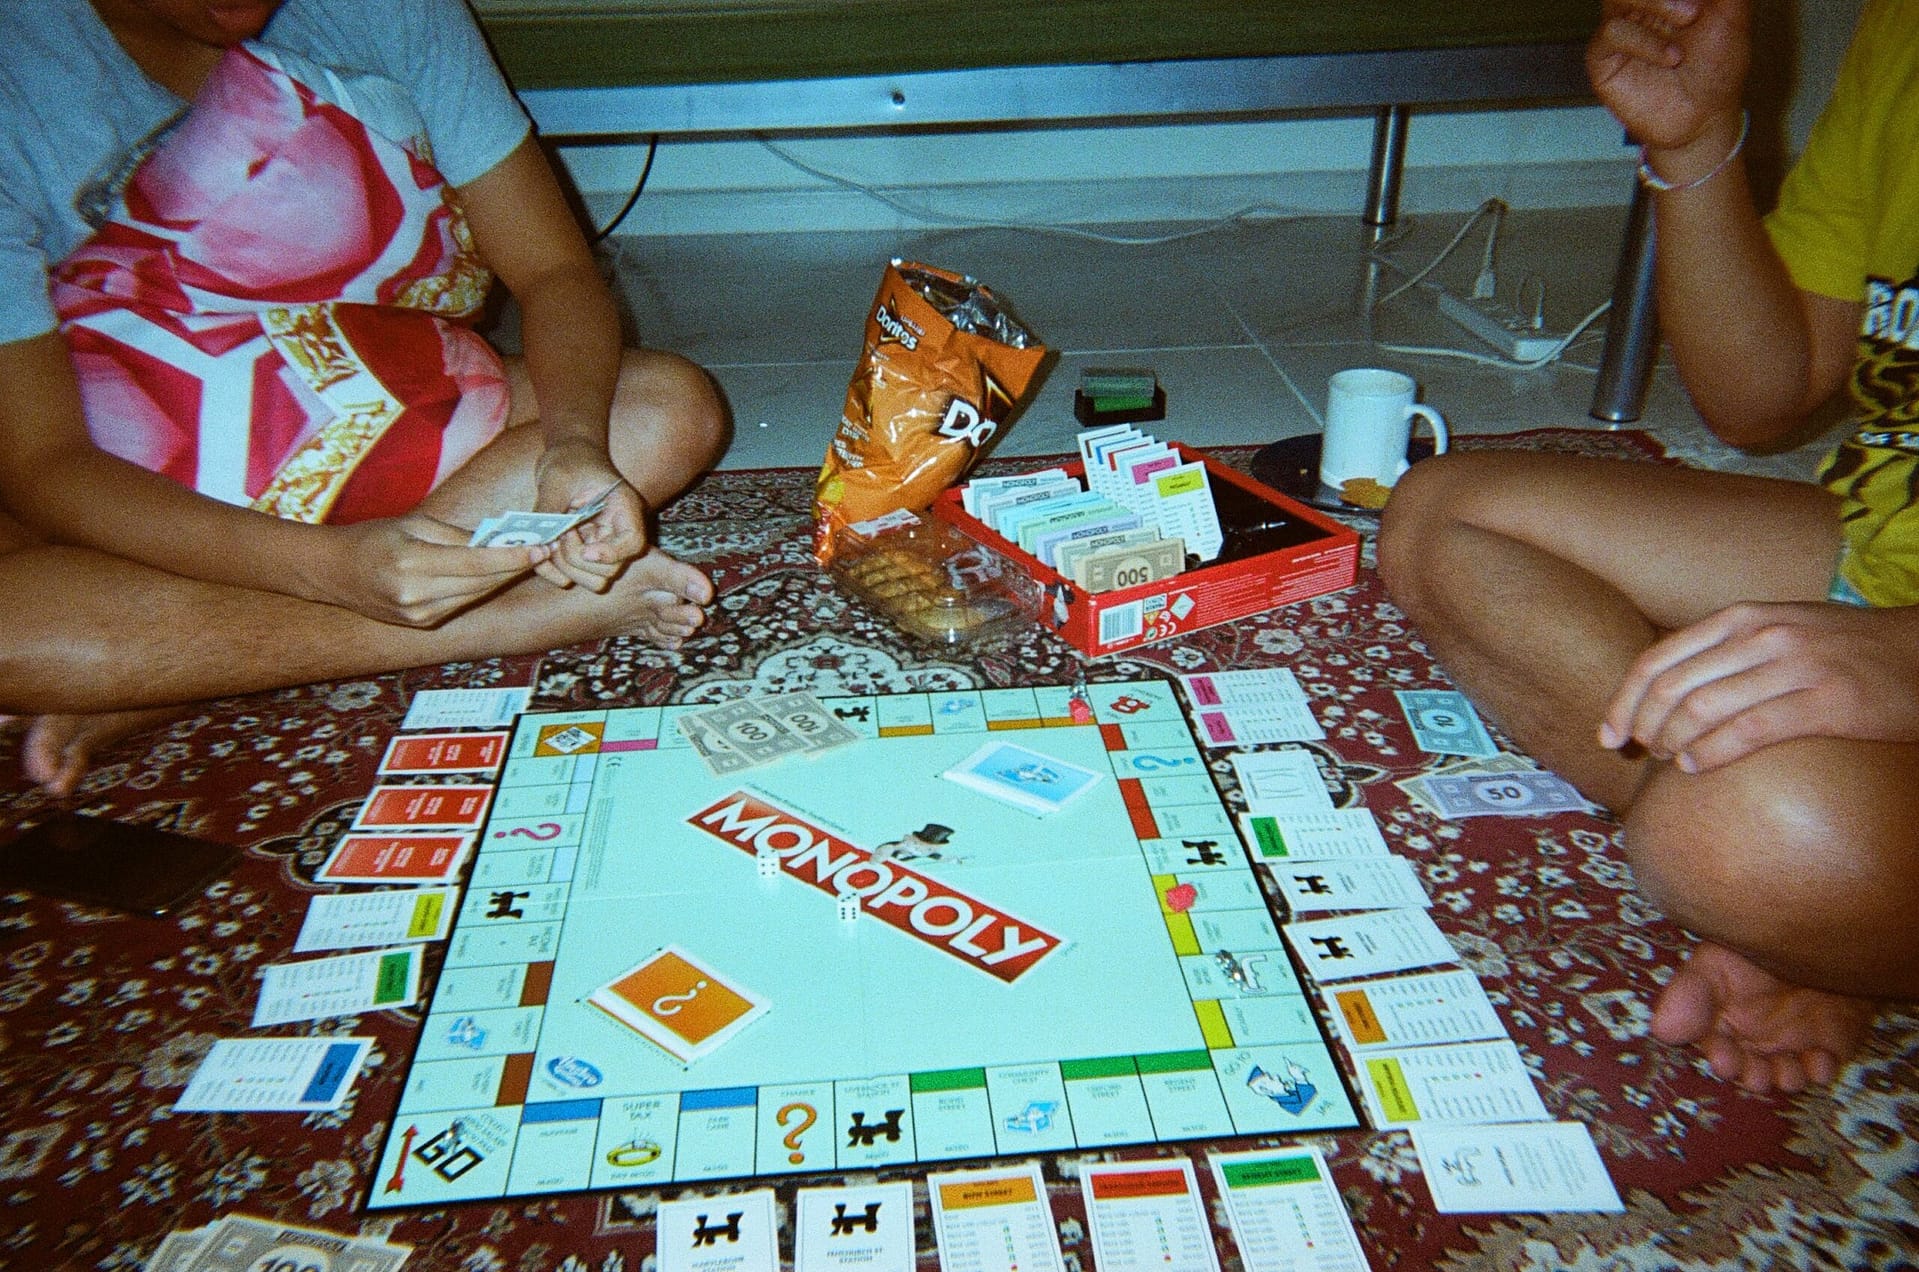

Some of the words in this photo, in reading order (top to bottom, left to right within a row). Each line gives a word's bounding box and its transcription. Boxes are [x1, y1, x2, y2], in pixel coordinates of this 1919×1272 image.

[876, 304, 918, 350] Doritos
[1117, 565, 1149, 587] 500
[735, 721, 769, 742] 100
[790, 713, 821, 733] 100
[1432, 714, 1455, 728] 10
[1486, 785, 1521, 801] 50
[701, 799, 1048, 966] MONOPOLY
[412, 1129, 486, 1183] GO
